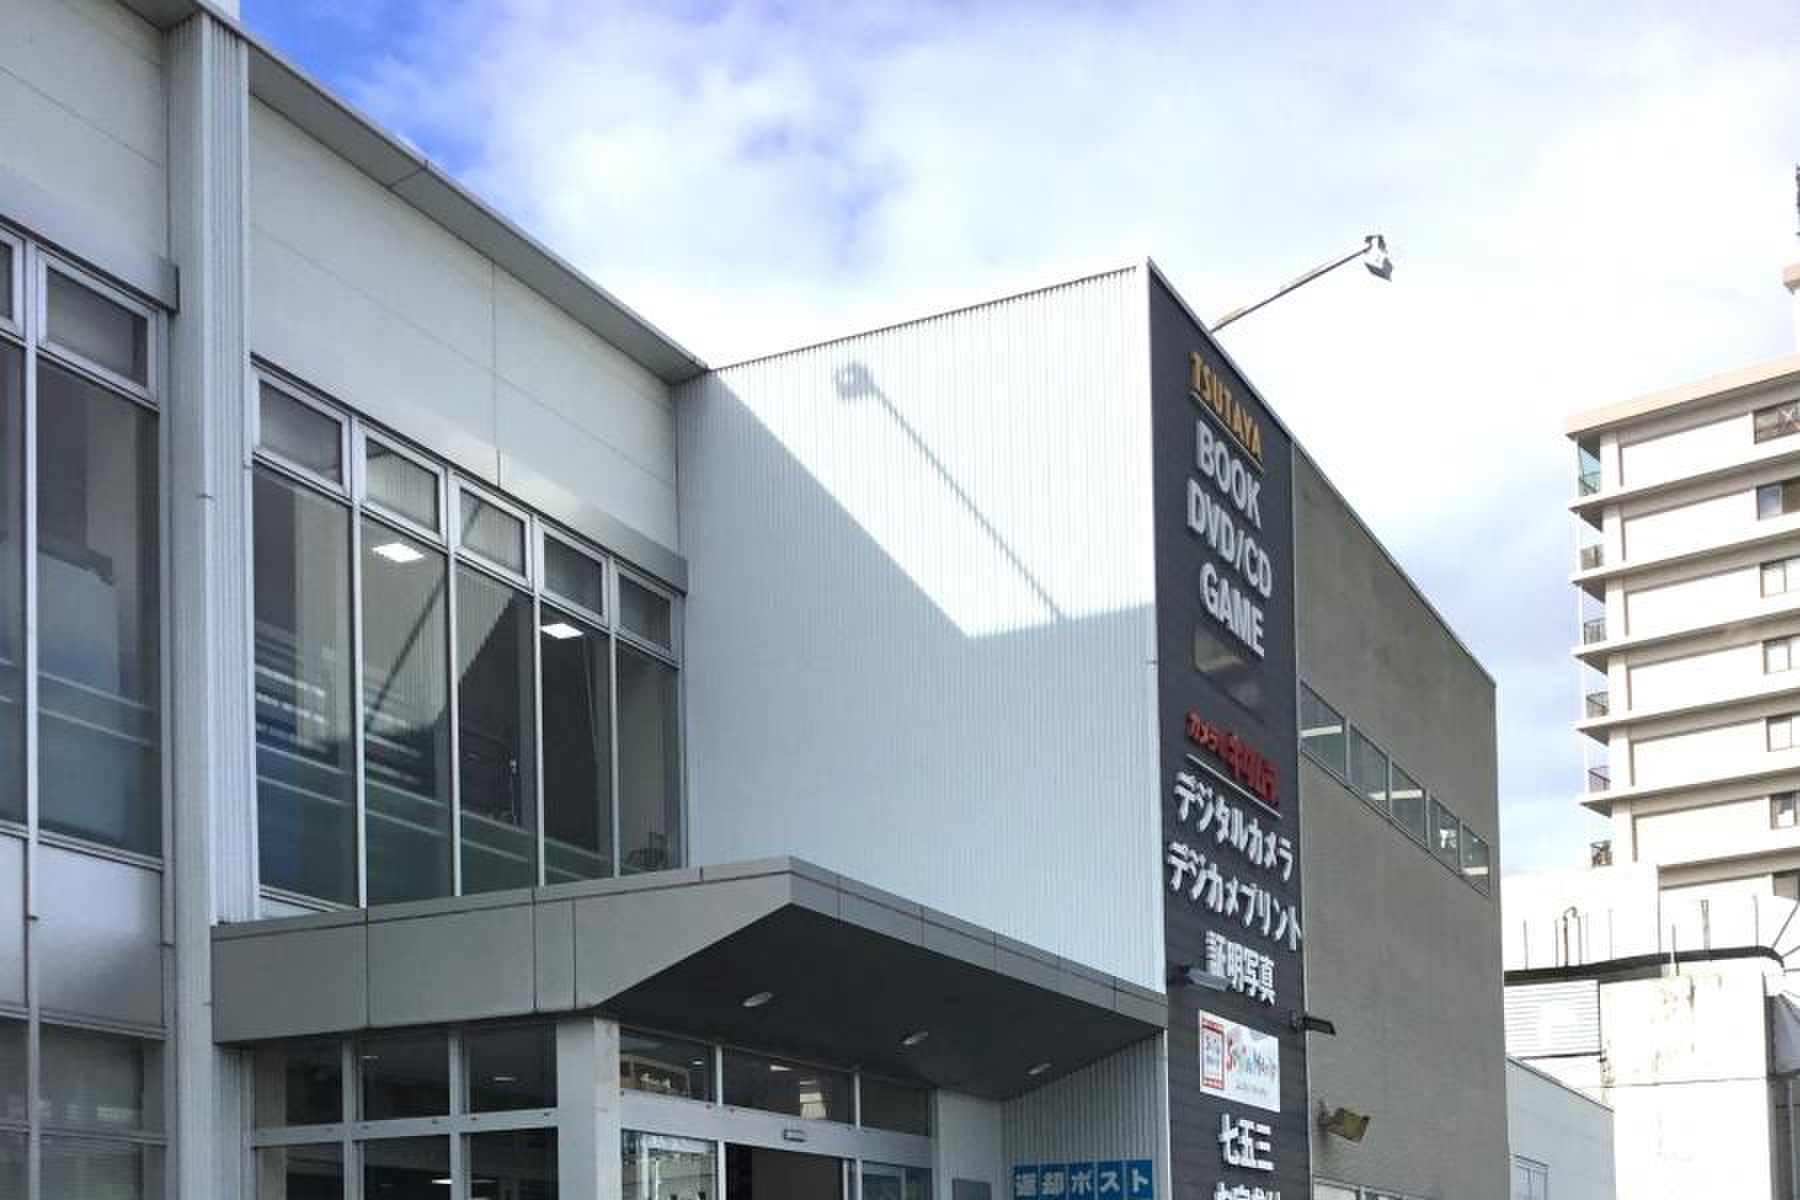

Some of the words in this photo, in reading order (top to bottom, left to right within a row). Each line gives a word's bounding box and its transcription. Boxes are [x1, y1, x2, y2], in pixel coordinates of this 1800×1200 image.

[1189, 351, 1263, 461] TSUTAYA
[1197, 419, 1261, 529] BOOK
[1187, 479, 1272, 598] DVD/CD
[1201, 562, 1264, 657] GAME
[1174, 771, 1294, 882] デジタルカメラ
[1167, 841, 1301, 951] デジカメプリント
[1205, 930, 1276, 1006] 証明写真
[1015, 1168, 1149, 1197] 返却ポスト
[1218, 1113, 1275, 1171] 七五三
